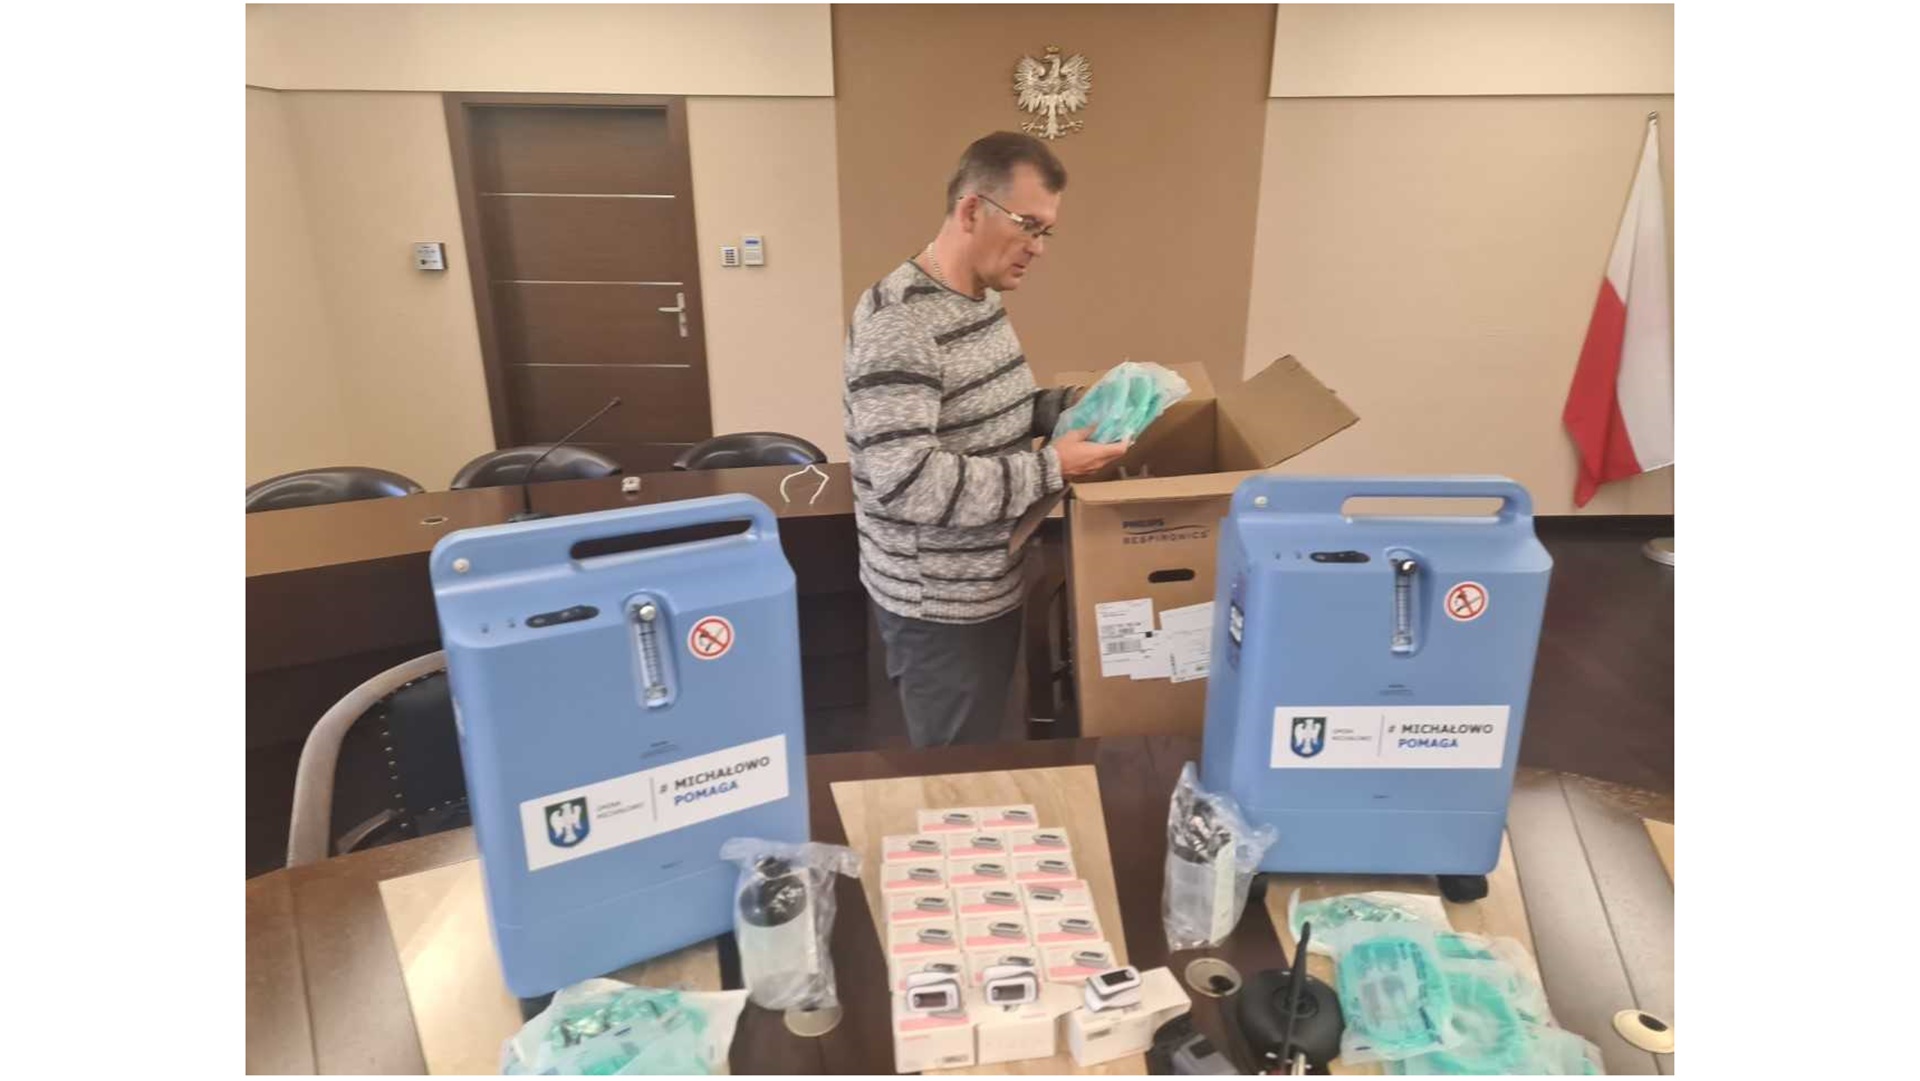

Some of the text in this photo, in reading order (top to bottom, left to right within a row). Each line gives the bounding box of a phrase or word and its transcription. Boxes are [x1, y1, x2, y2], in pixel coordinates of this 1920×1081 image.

[1401, 723, 1494, 735] MICHAŁOWO
[1398, 738, 1459, 749] POMAGA
[674, 755, 771, 791] MICHAŁOWO
[674, 780, 739, 807] POMAGA
